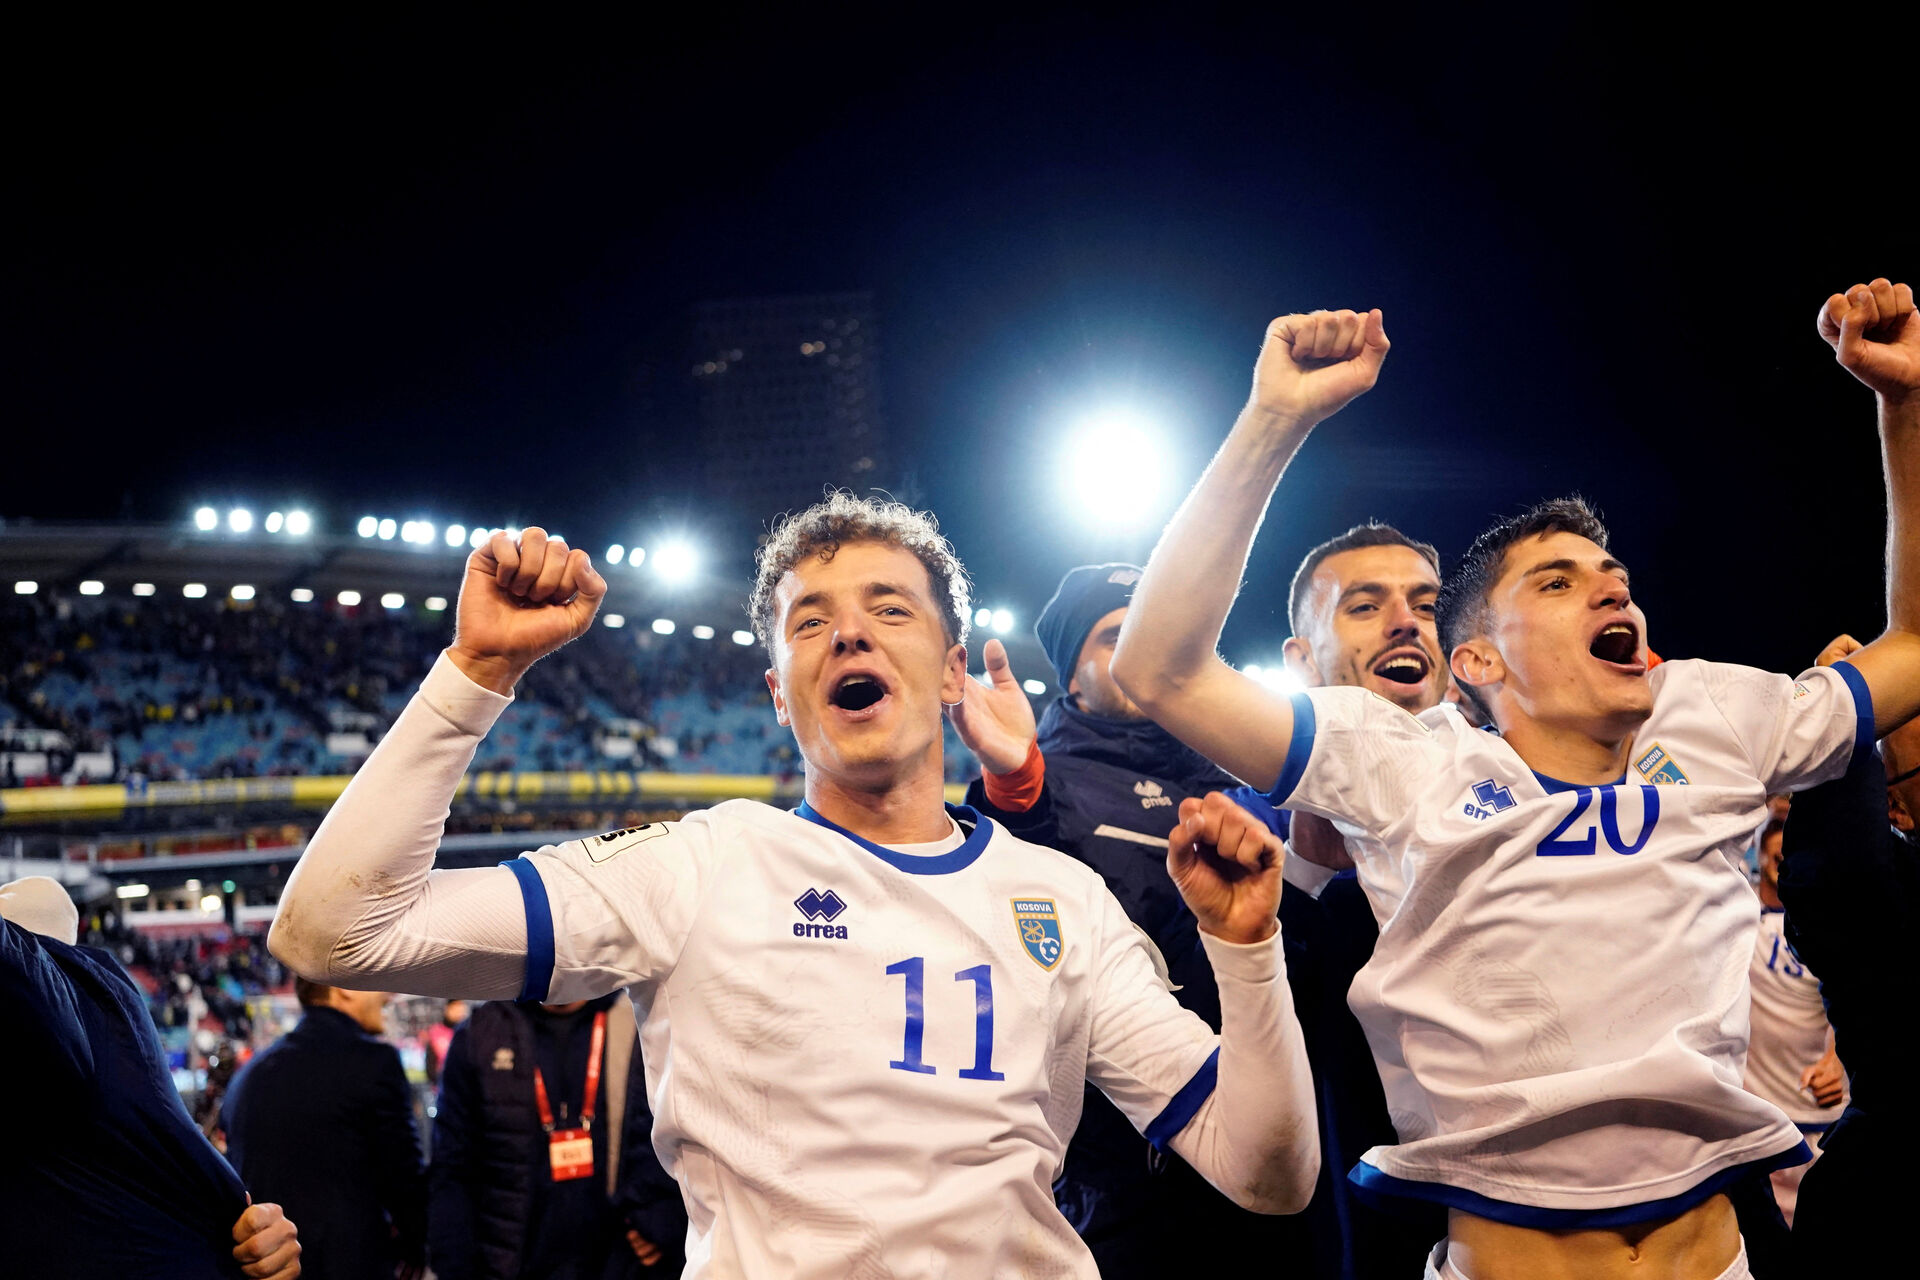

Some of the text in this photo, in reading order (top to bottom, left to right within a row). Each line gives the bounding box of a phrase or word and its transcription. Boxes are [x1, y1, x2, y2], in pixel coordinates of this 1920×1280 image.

[1639, 749, 1664, 772] KOSOVA
[1141, 796, 1173, 809] errea
[1463, 802, 1495, 821] err
[1536, 785, 1660, 857] 20
[1016, 902, 1052, 912] KOSOVA
[793, 922, 848, 940] errea
[885, 956, 1005, 1082] 11
